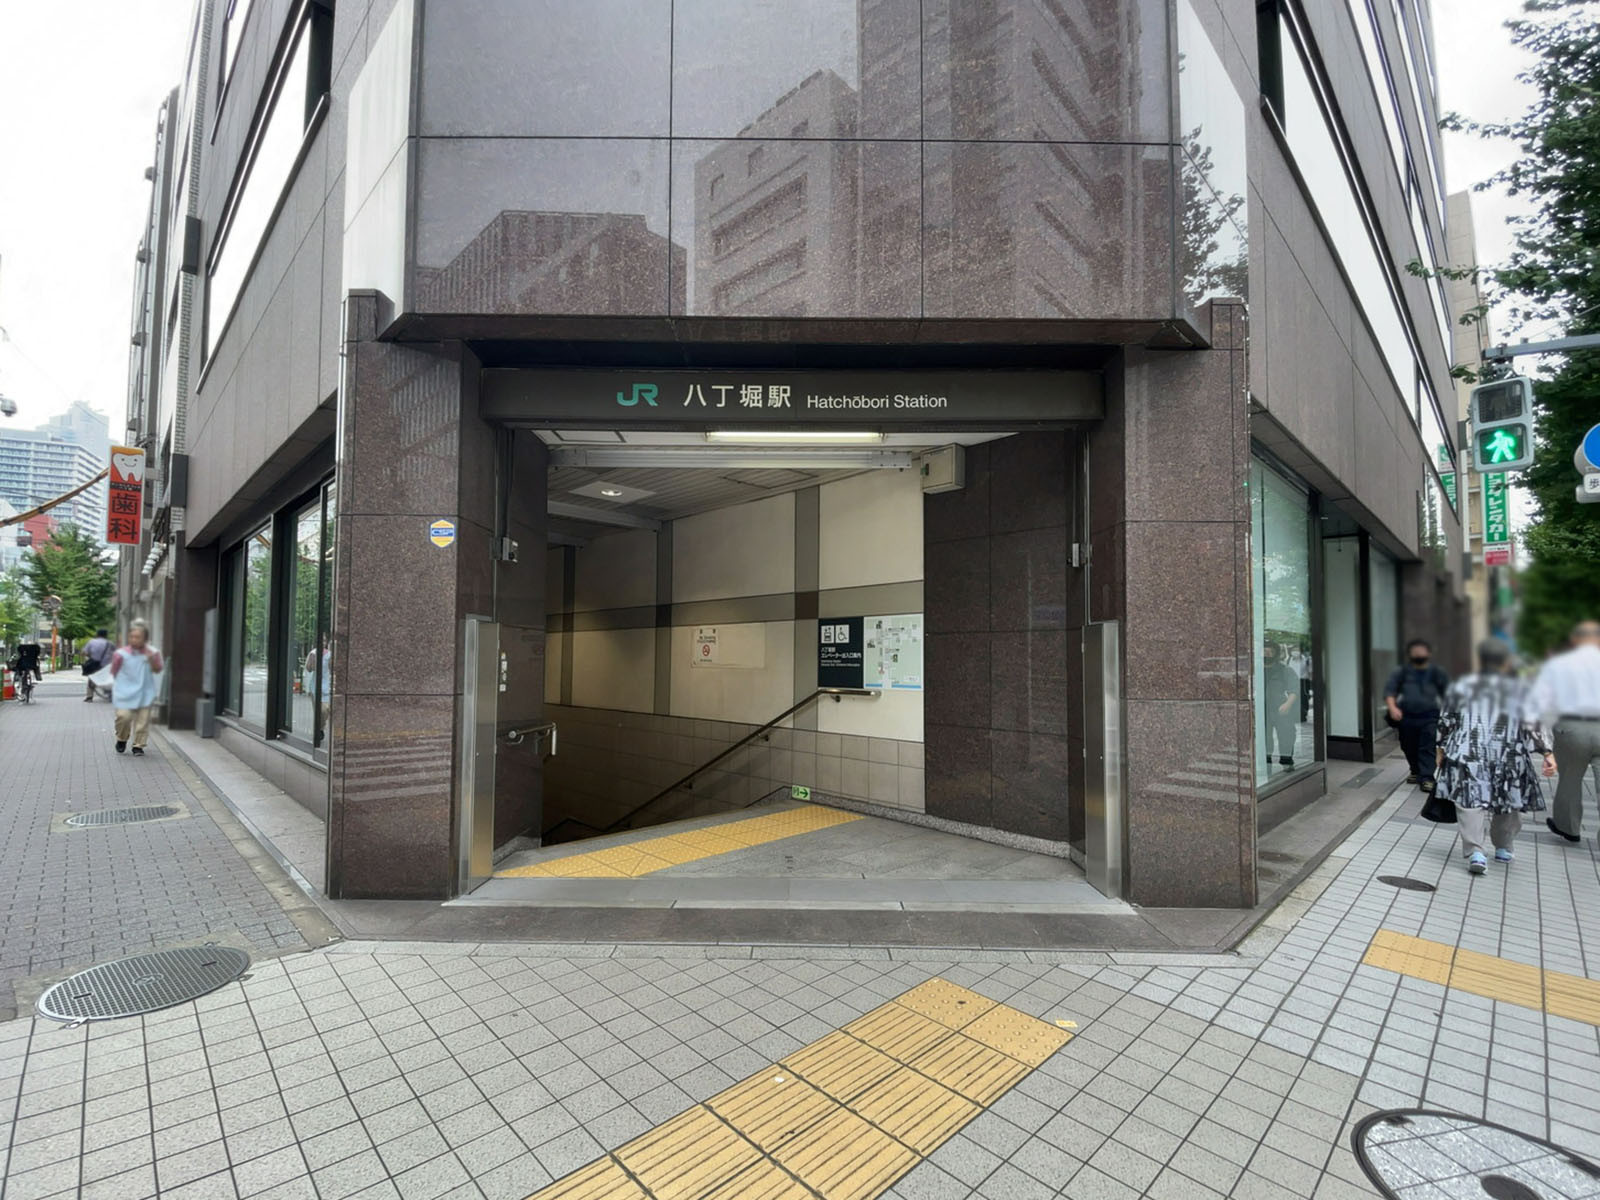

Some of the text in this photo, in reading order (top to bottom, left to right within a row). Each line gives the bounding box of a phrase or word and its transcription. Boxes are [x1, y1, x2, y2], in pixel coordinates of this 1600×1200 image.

[616, 383, 659, 407] JR
[683, 384, 791, 408] 八丁堀駅
[893, 394, 947, 409] Station
[109, 493, 138, 541] 歯科
